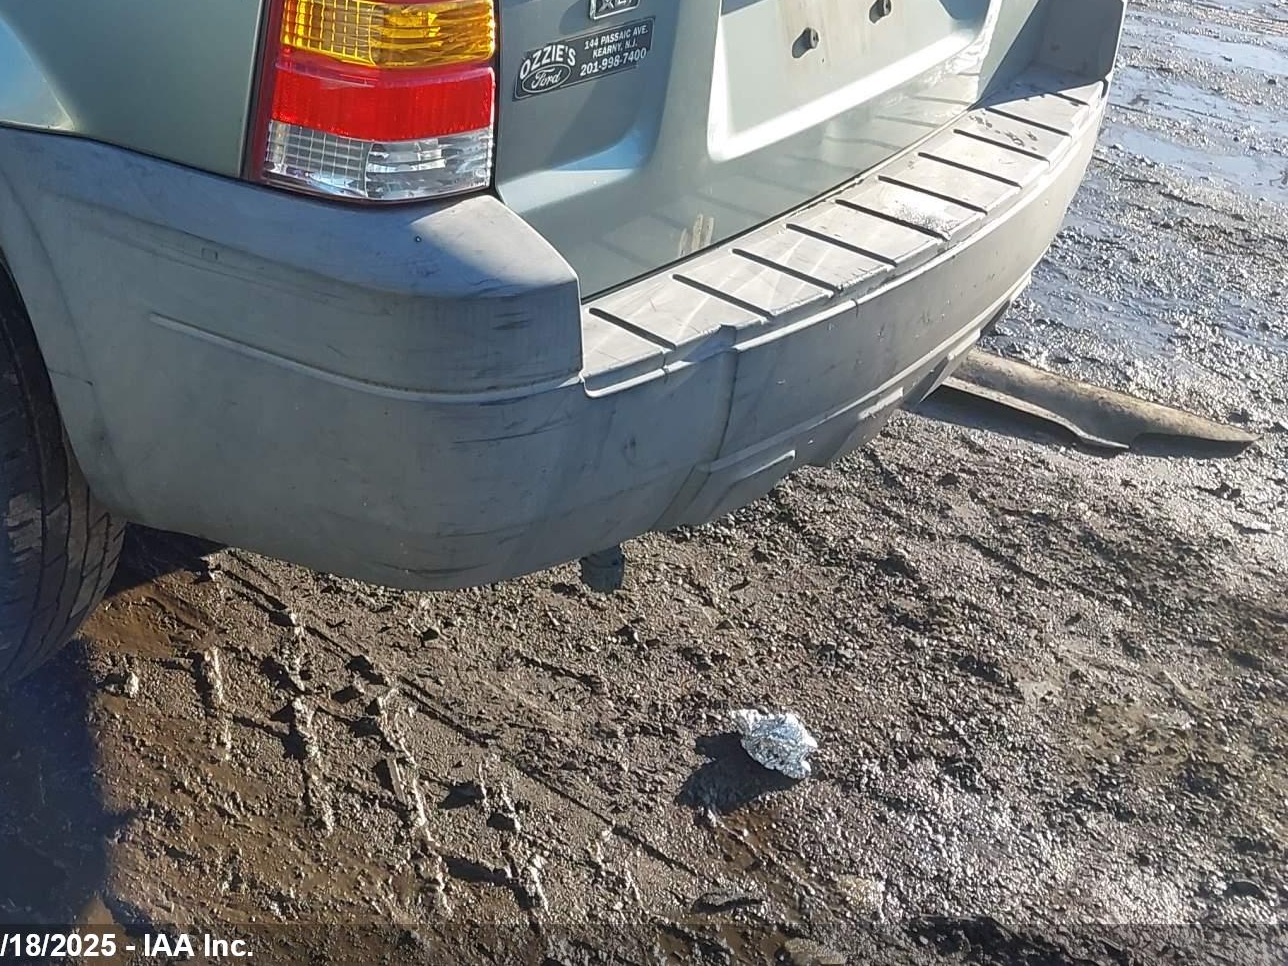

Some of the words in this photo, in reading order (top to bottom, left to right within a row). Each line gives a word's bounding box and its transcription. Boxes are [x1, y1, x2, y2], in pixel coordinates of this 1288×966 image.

[584, 37, 599, 50] 144
[600, 27, 631, 44] PASSAIC
[632, 24, 649, 36] AVE.
[624, 38, 638, 50] N.J.
[519, 44, 576, 79] OZZIE'S
[579, 48, 647, 76] 201-998-7400
[531, 68, 561, 89] Ford
